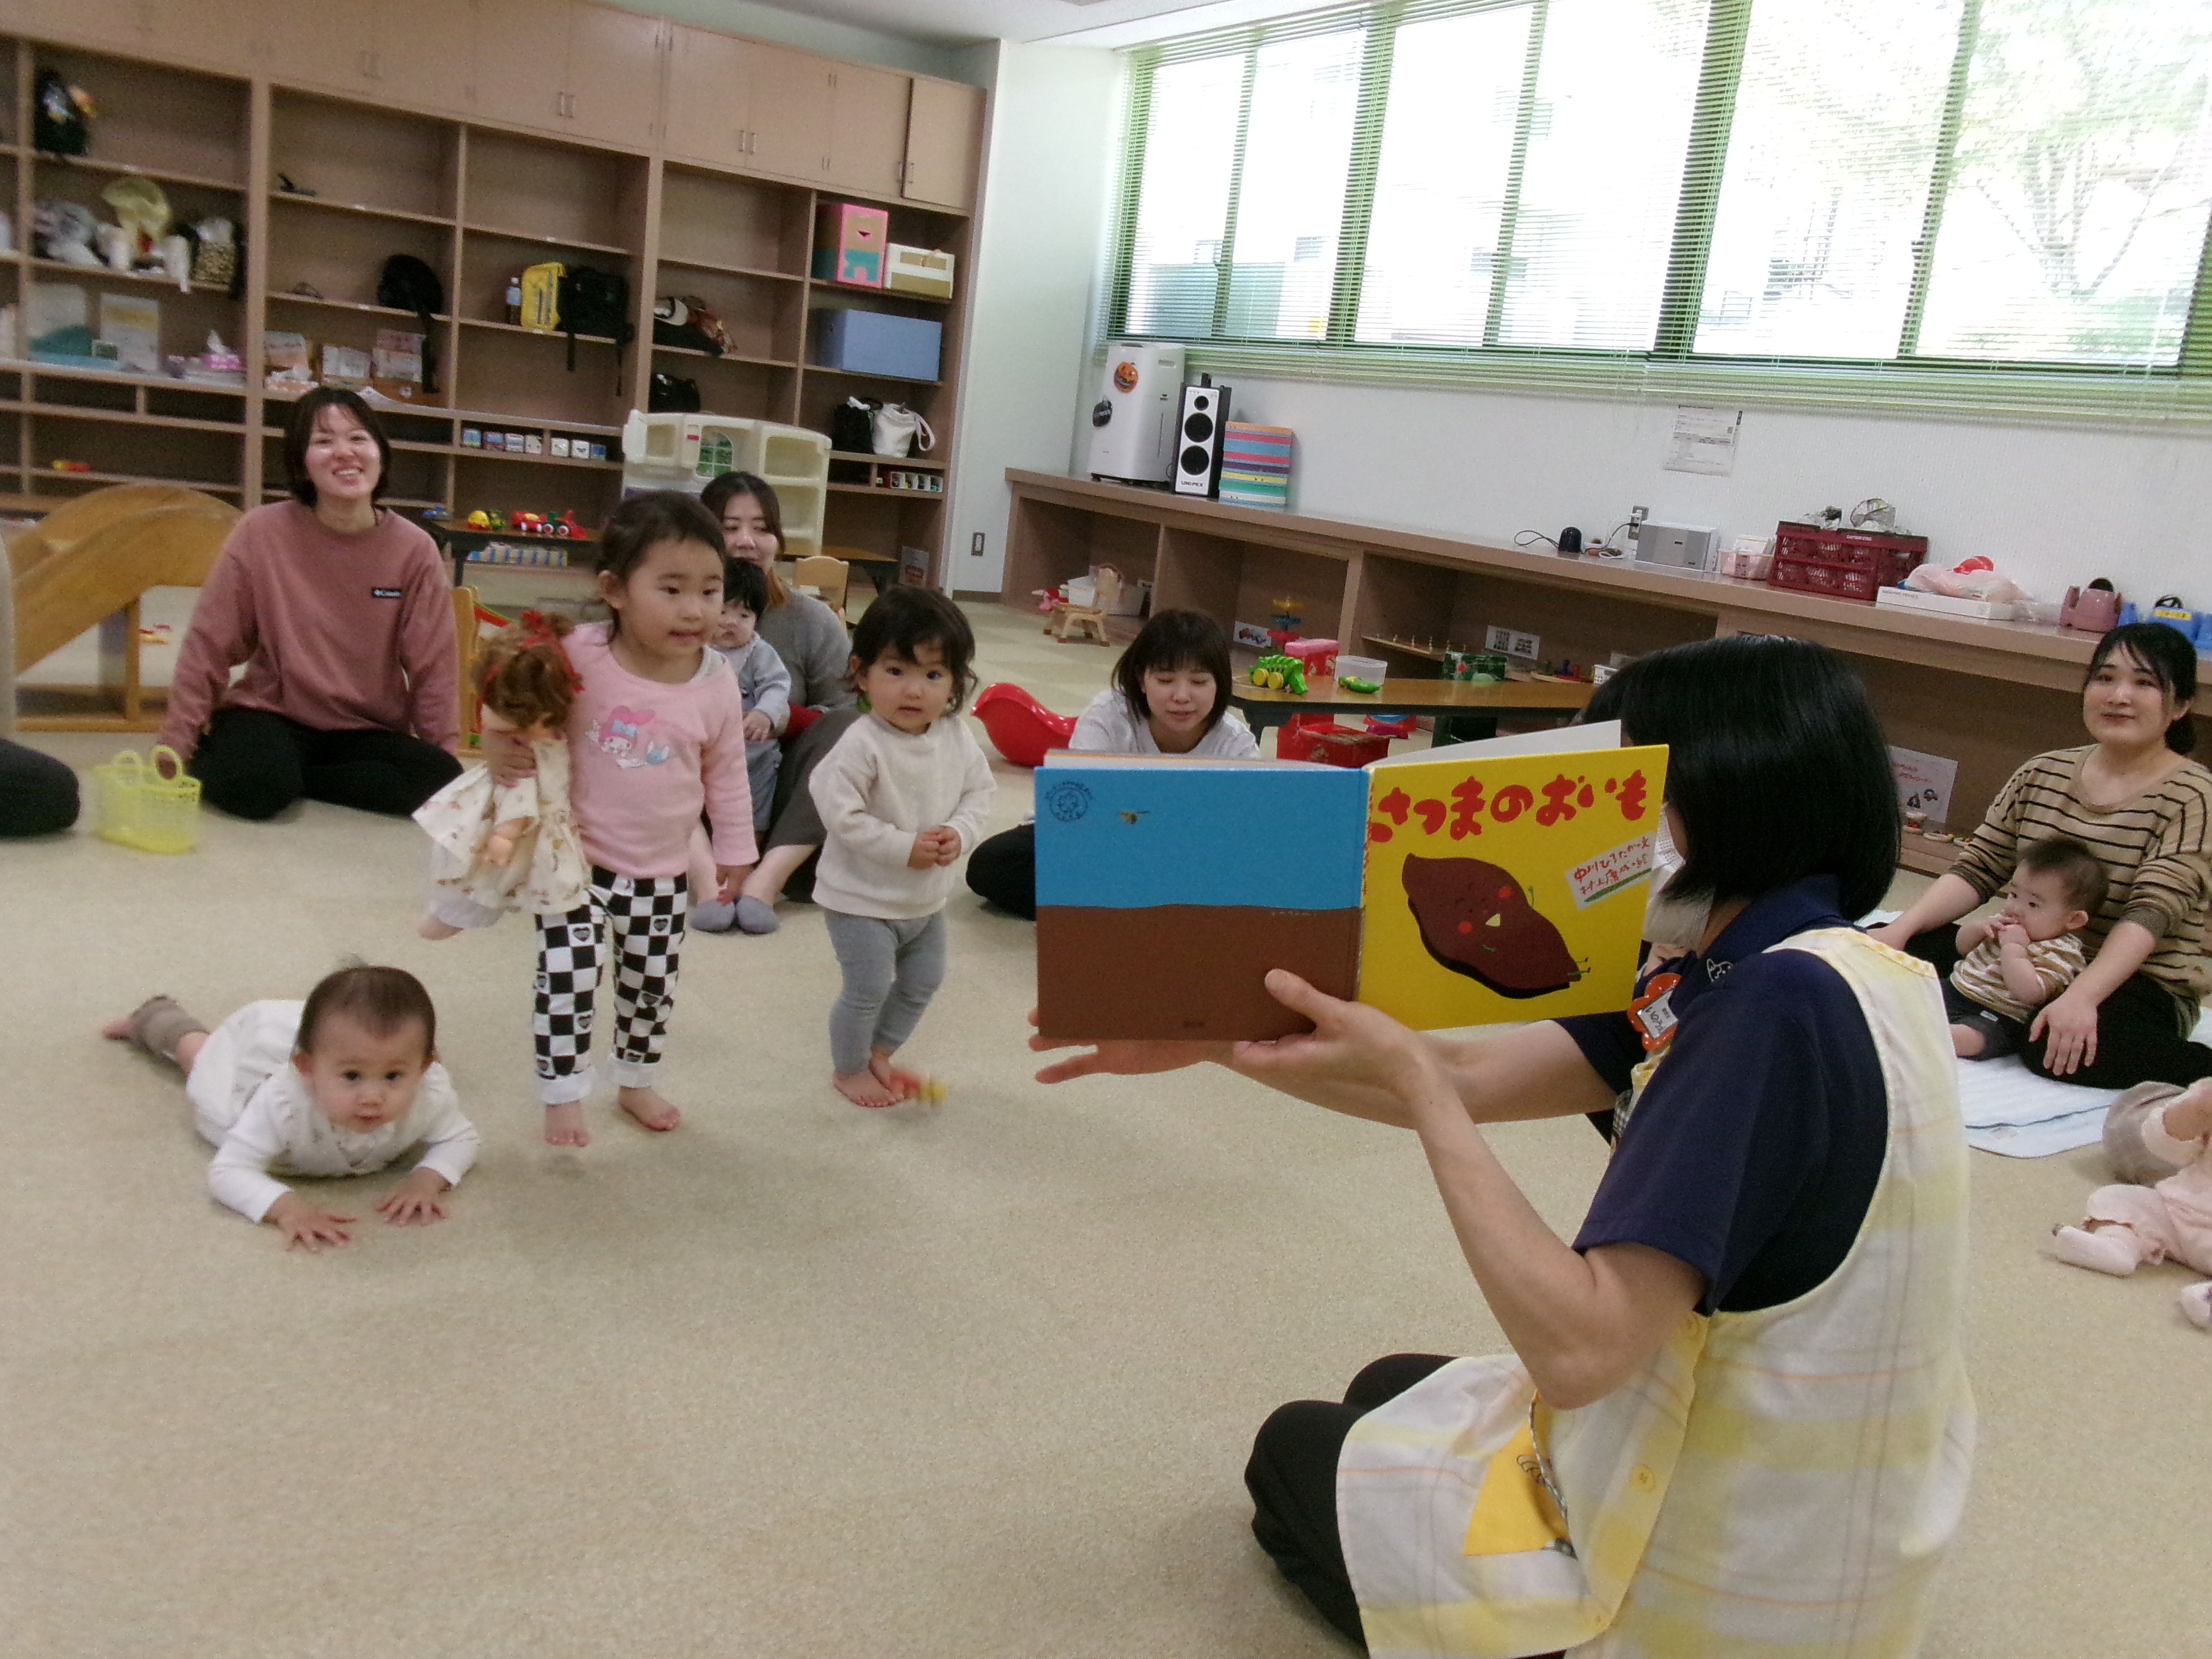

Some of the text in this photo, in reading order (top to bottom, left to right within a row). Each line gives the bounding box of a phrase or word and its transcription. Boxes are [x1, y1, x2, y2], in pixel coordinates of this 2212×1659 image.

[1368, 769, 1647, 843] さつまのおいも
